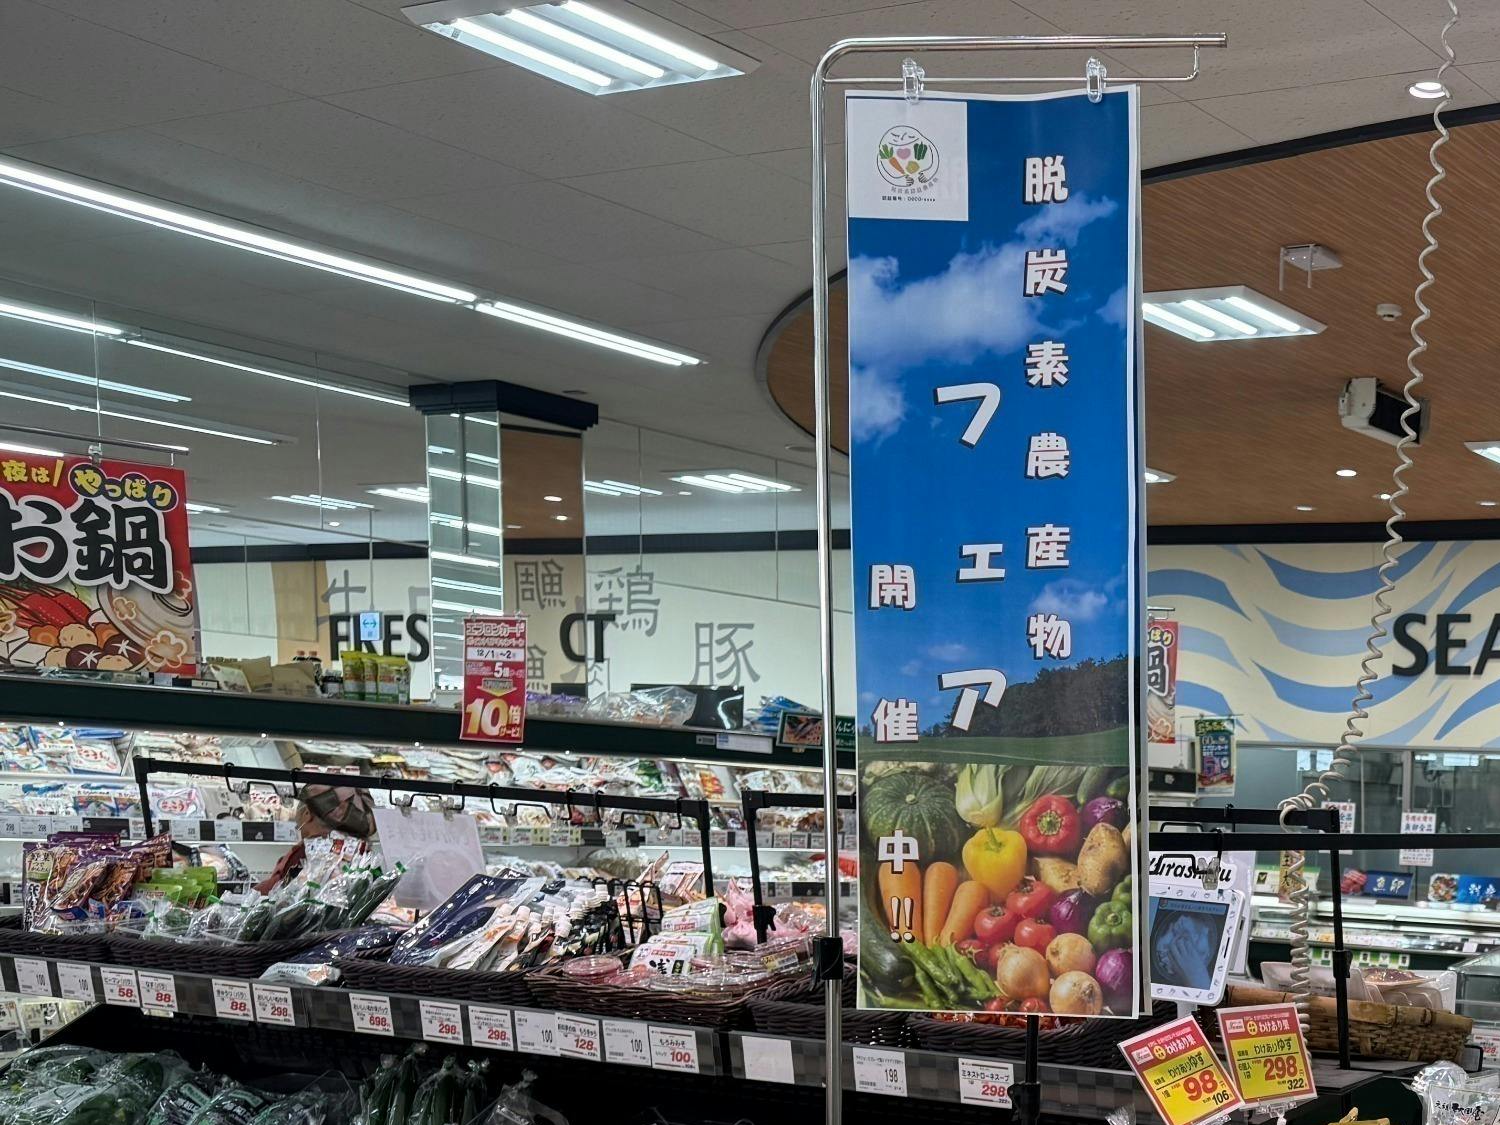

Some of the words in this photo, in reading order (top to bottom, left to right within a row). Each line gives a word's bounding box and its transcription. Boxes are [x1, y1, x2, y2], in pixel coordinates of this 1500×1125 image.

[1024, 155, 1072, 659] 脱炭素農産物
[73, 469, 172, 508] やっぱり
[0, 492, 168, 589] お鍋
[691, 621, 761, 686] 豚
